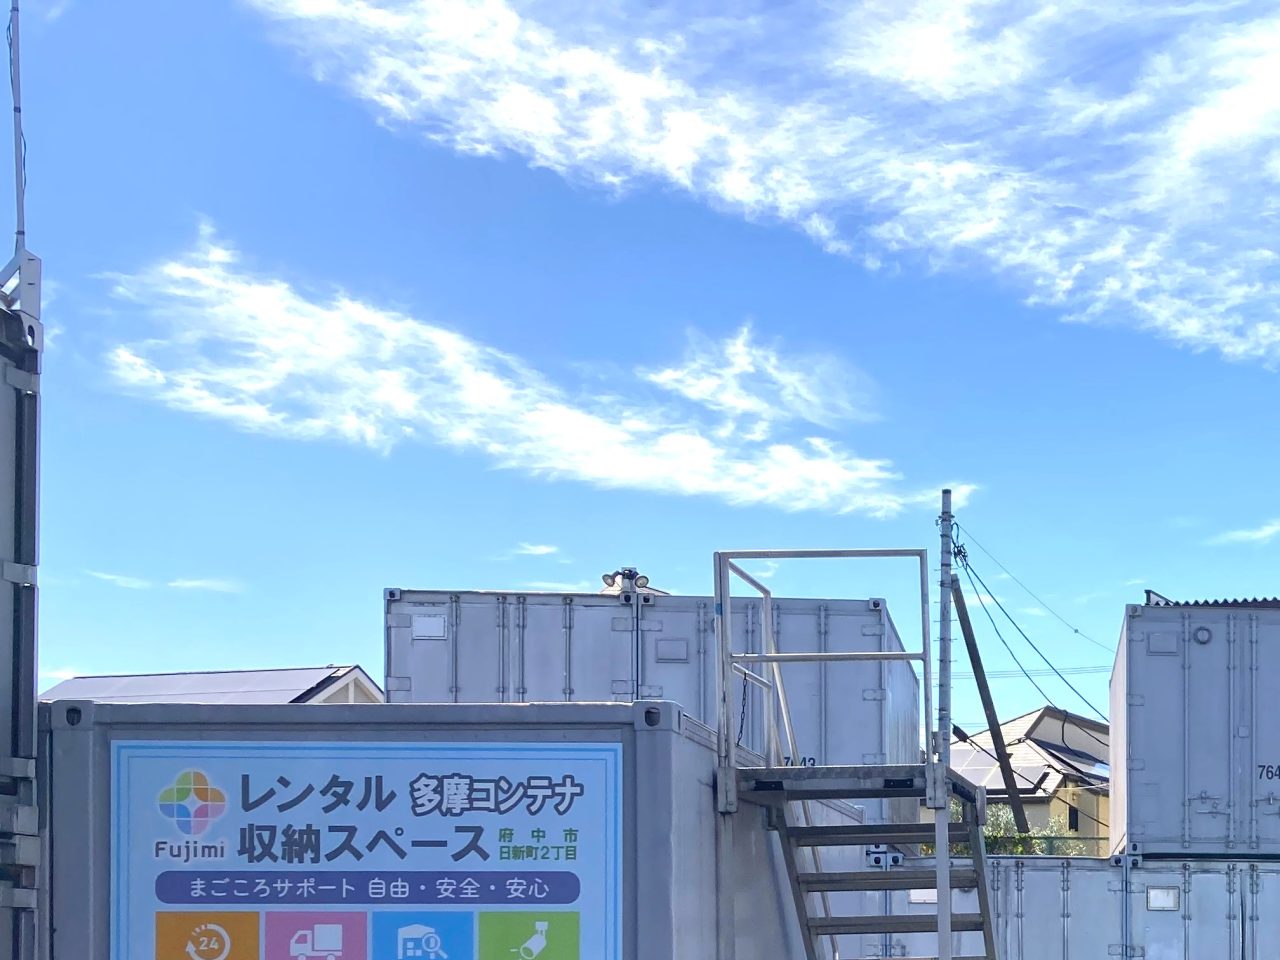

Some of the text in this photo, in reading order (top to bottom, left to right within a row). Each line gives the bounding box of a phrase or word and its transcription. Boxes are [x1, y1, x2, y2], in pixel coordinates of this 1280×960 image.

[240, 773, 584, 816] レンタル 多摩コンテナ
[154, 840, 226, 864] Fujimi
[237, 824, 491, 864] 収納スペース
[498, 844, 578, 861] 日新町2丁目
[190, 878, 550, 900] まごころサポート 自由・安全・安心
